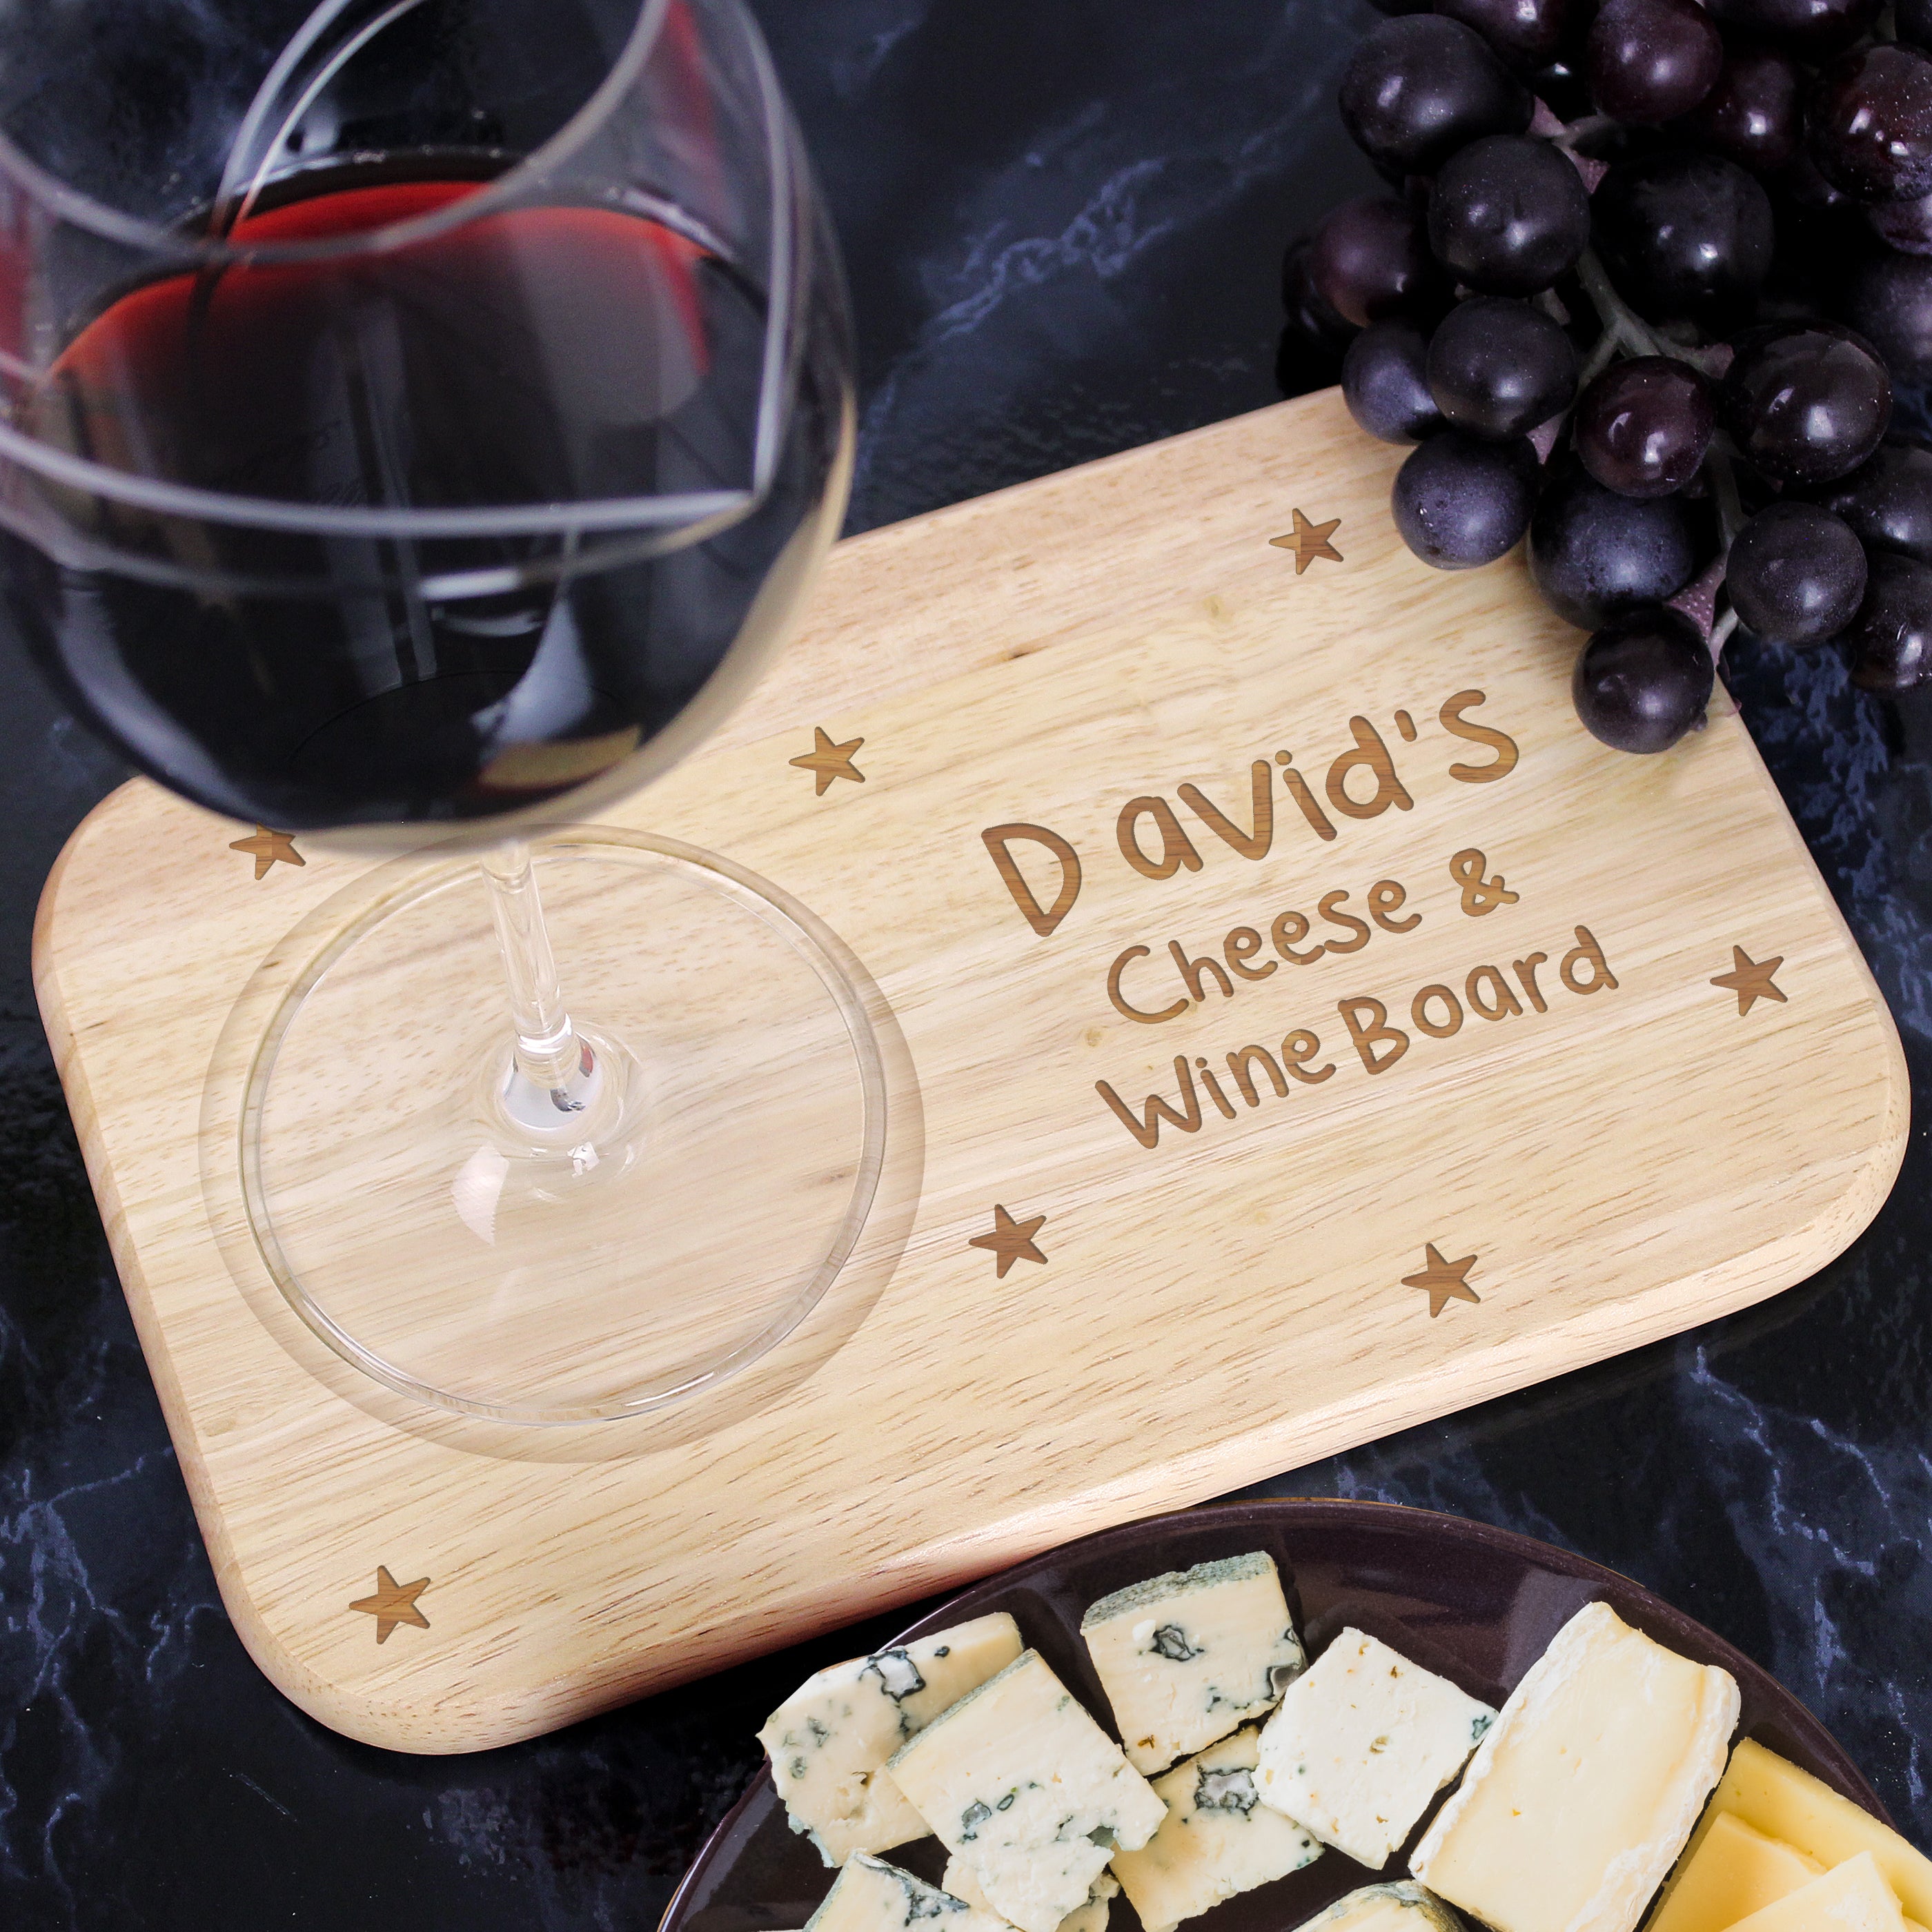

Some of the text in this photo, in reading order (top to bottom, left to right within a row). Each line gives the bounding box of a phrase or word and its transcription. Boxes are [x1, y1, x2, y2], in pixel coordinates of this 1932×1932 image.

[1107, 847, 1520, 1025] Cheese &
[1094, 925, 1619, 1150] Wine Board
